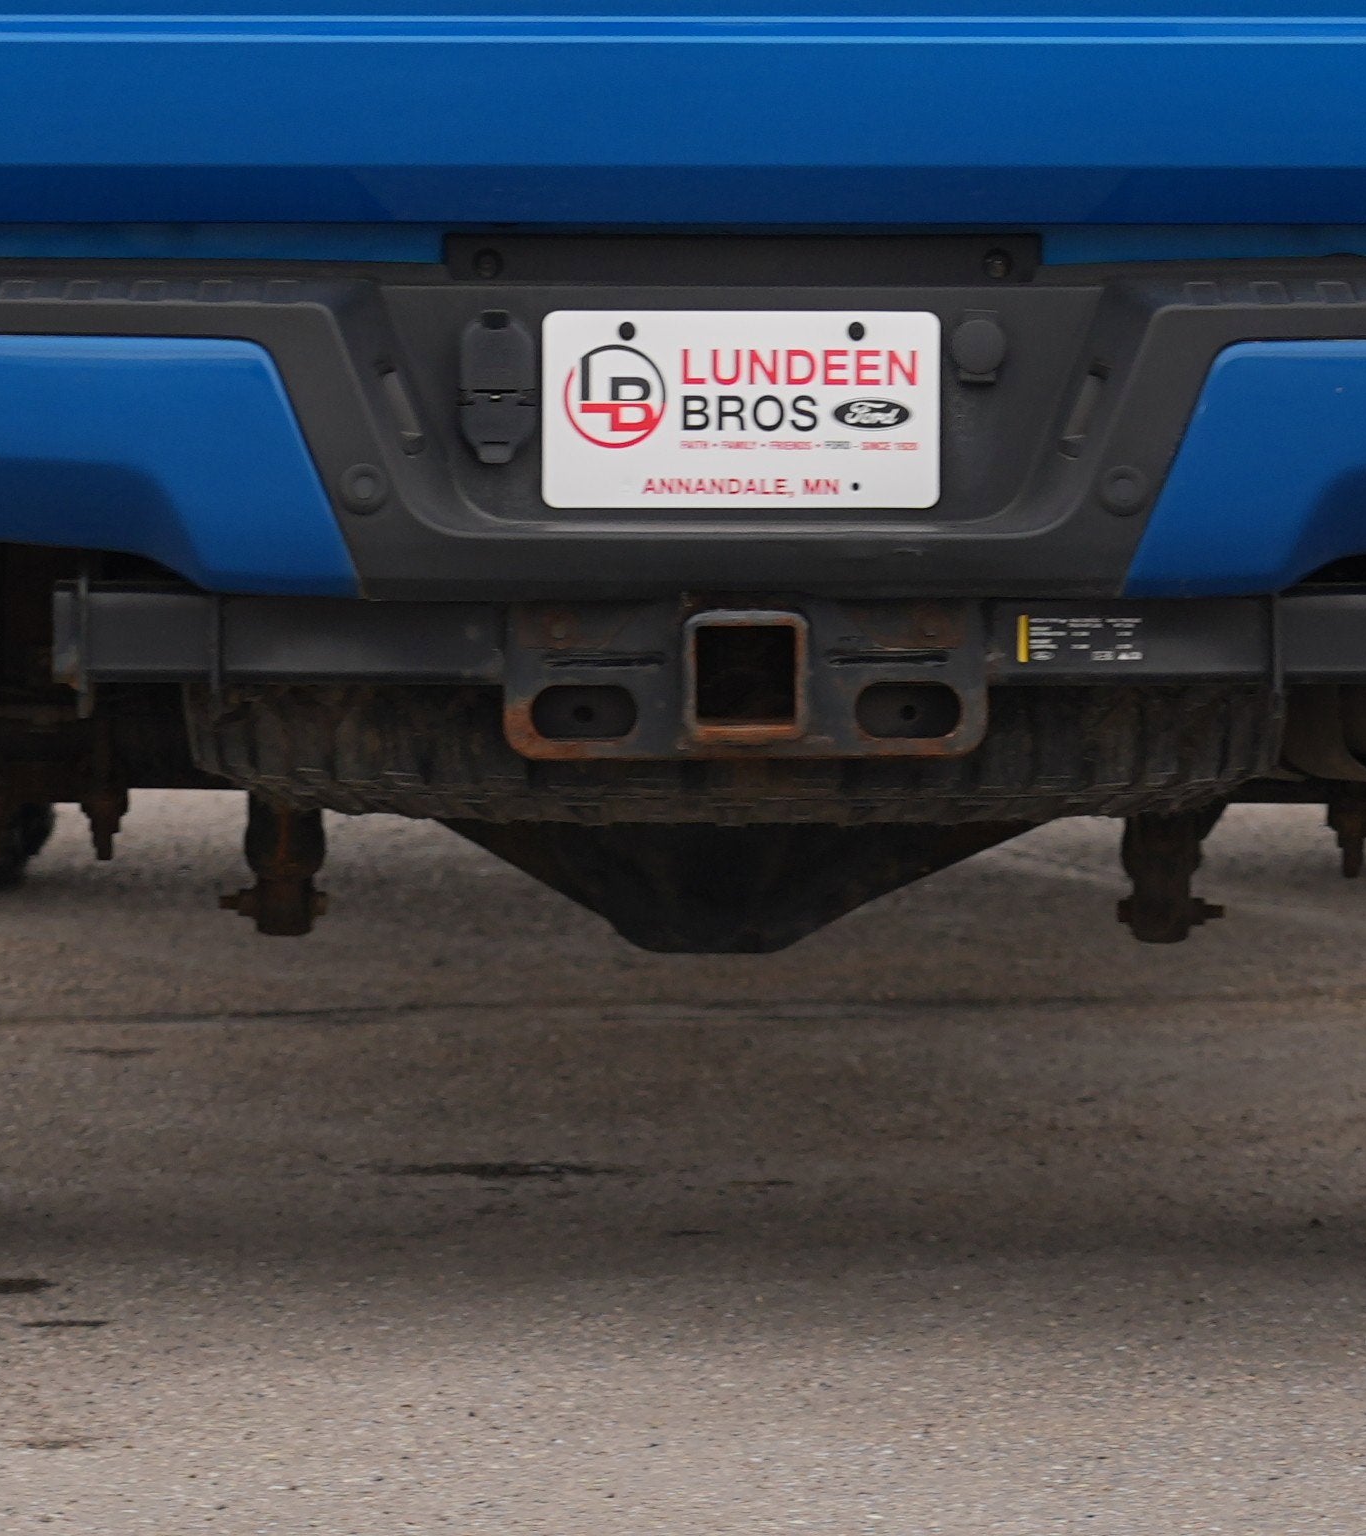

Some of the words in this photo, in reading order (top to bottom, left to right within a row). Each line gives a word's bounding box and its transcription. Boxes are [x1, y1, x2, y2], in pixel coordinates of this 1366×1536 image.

[680, 348, 919, 387] LUNDEEN
[681, 394, 820, 433] BROS
[842, 401, 903, 426] Ford
[641, 478, 796, 498] ANNANDALE,
[802, 478, 841, 496] MN
